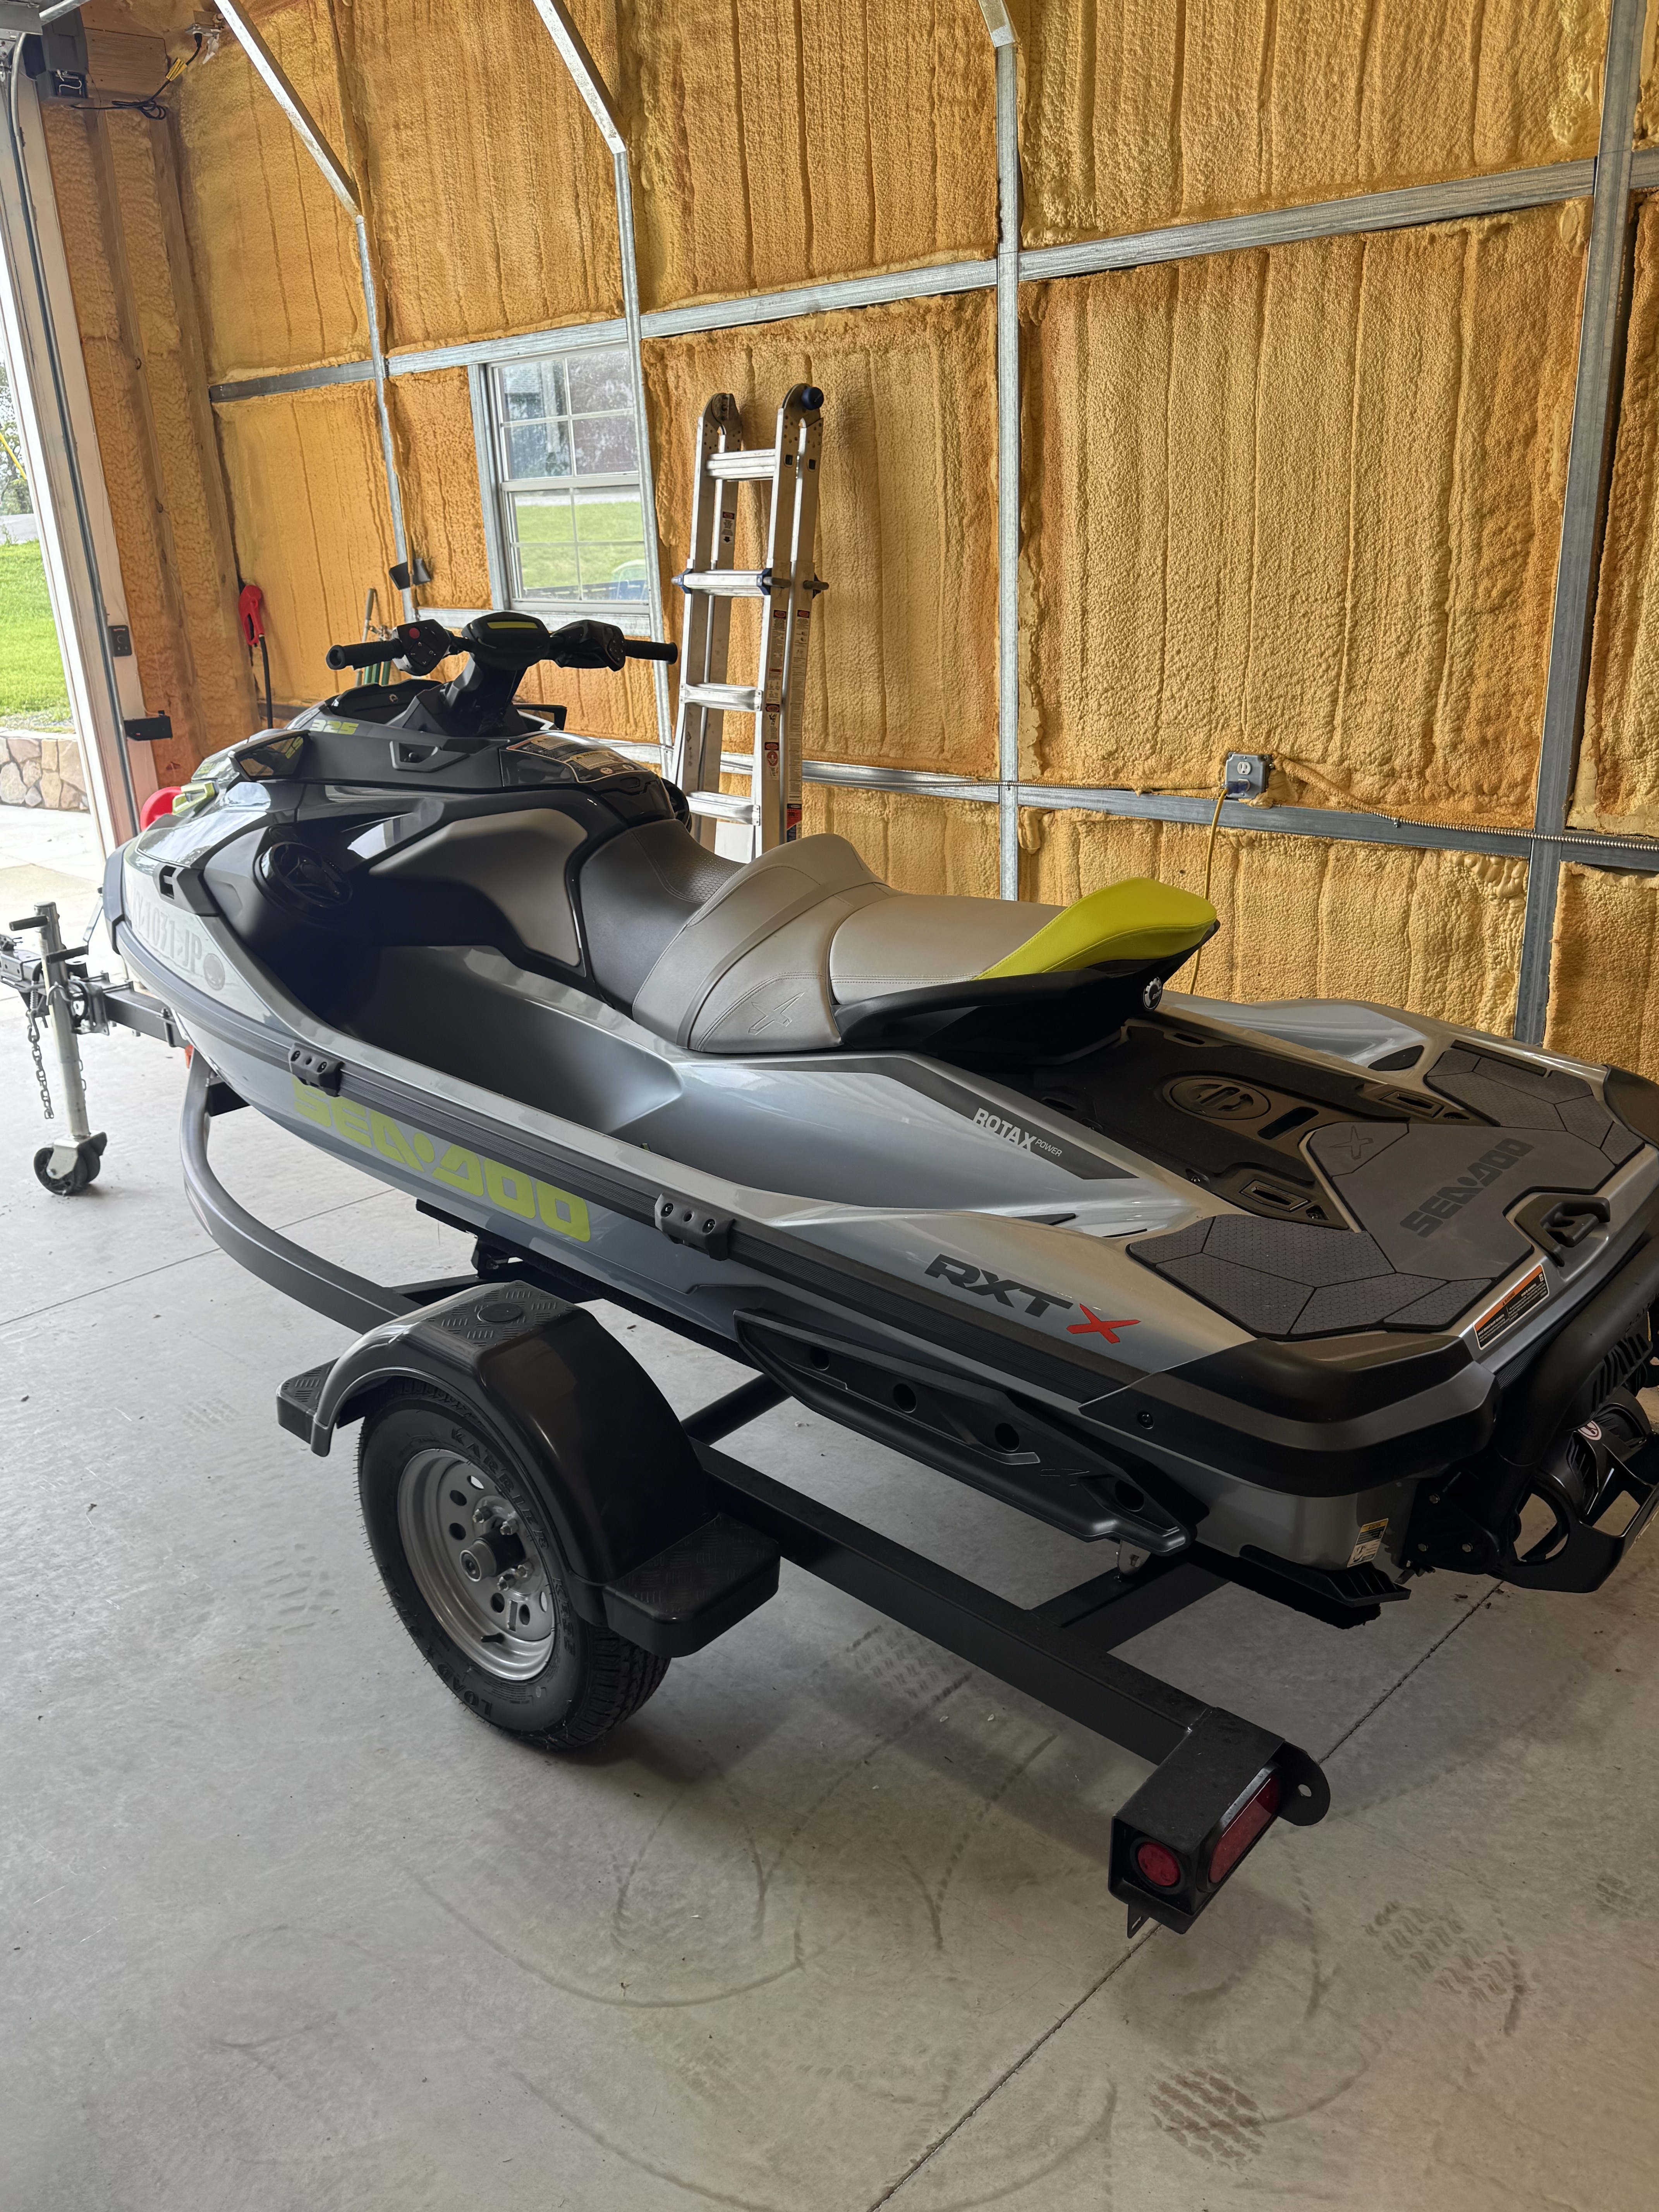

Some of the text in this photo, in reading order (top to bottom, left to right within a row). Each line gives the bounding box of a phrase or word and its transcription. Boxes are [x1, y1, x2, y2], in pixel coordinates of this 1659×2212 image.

[310, 719, 359, 735] 325
[973, 1108, 1063, 1157] ROTAX POWER
[924, 1254, 1141, 1344] RXT X
[452, 1427, 549, 1549] KARRIER
